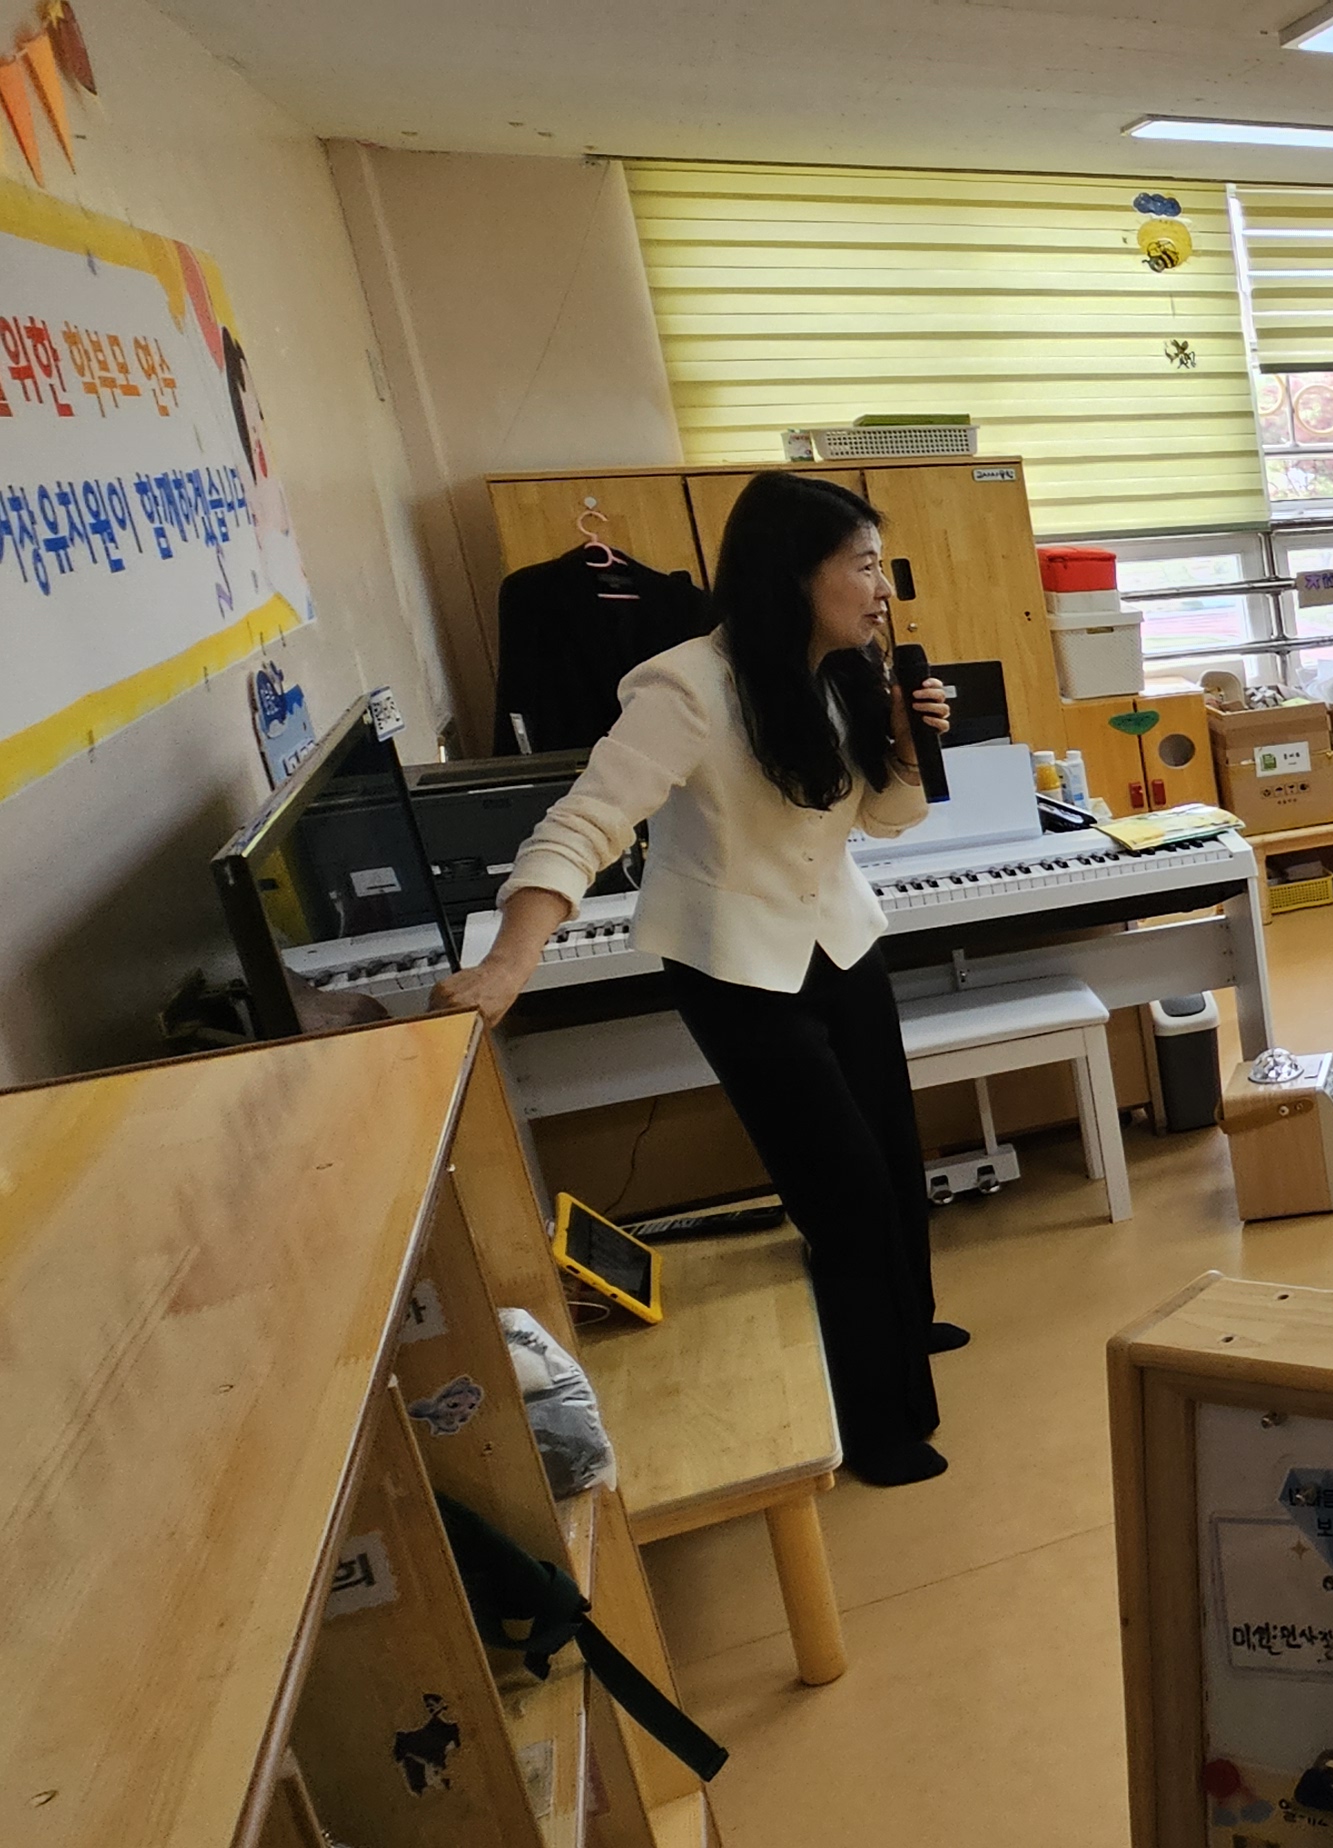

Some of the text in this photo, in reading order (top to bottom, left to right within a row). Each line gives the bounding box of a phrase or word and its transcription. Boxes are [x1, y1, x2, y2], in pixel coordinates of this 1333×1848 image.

[62, 320, 142, 419] 학부모
[132, 335, 180, 417] 연수
[133, 464, 252, 561] 함께하겠습니다
